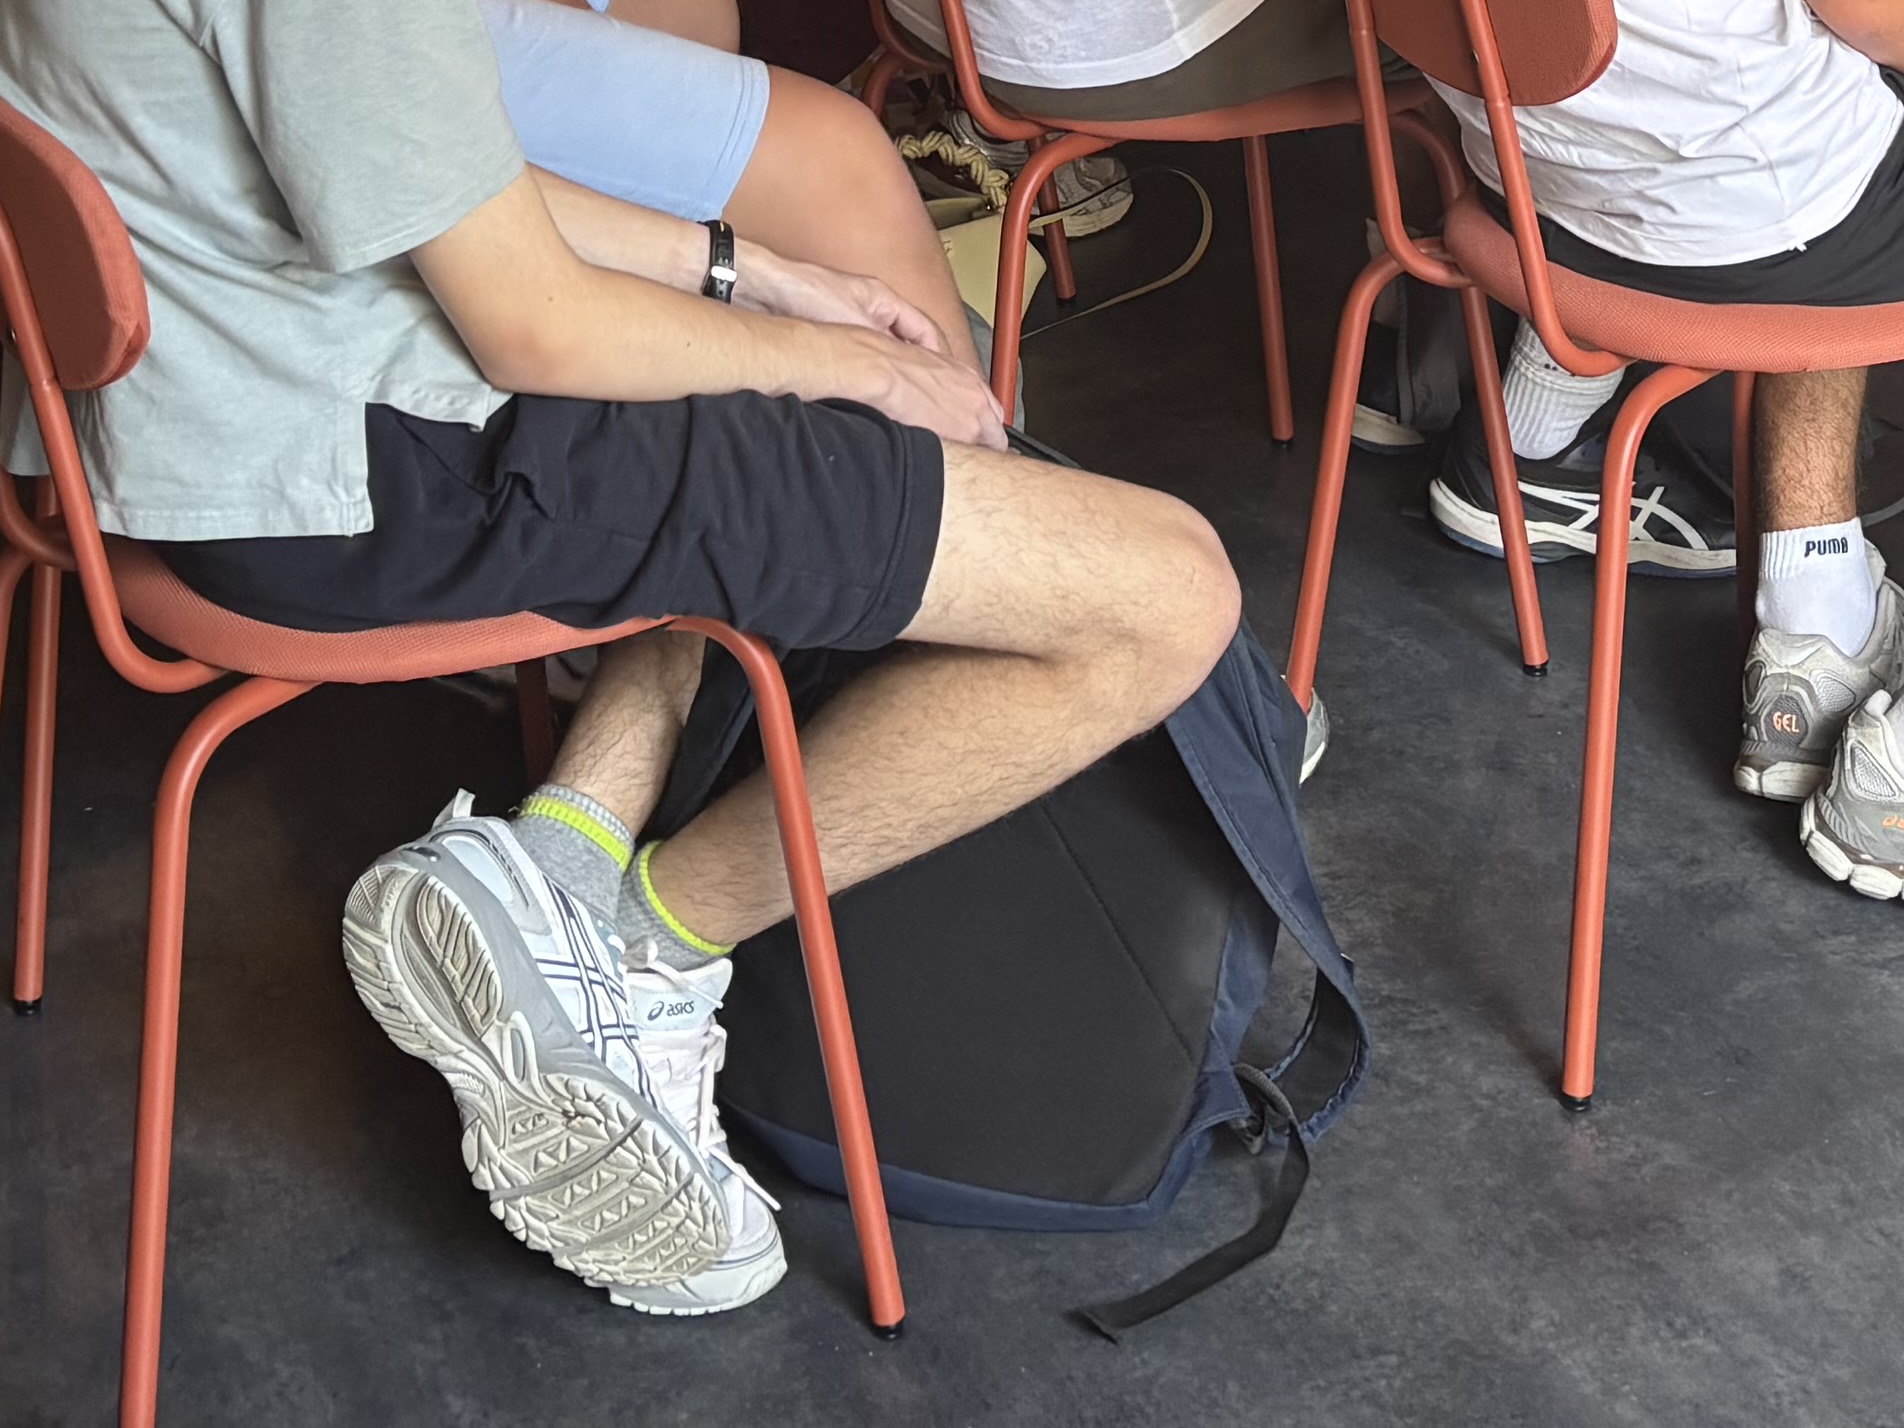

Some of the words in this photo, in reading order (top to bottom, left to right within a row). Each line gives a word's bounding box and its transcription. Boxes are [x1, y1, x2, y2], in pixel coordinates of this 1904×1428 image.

[1804, 536, 1849, 558] PUMA
[1772, 710, 1800, 733] GEL
[666, 1000, 695, 1017] asics
